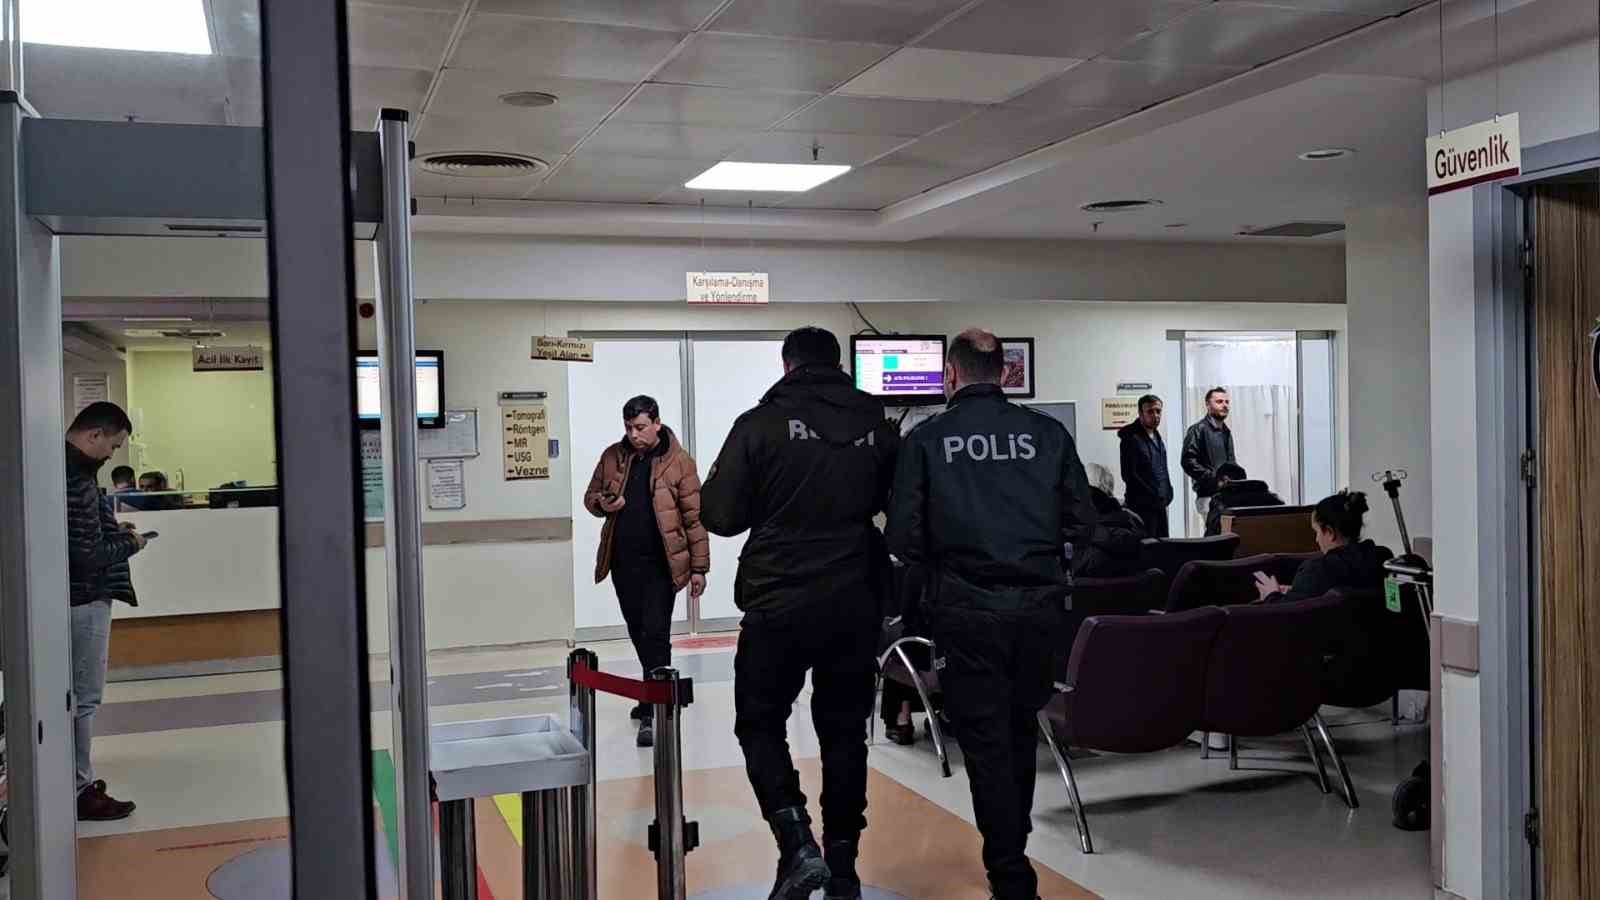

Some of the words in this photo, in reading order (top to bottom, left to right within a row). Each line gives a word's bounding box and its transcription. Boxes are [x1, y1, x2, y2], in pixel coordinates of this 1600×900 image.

[1434, 133, 1510, 179] Güvenlik
[512, 424, 546, 437] Röntgen
[514, 438, 528, 448] MR
[514, 451, 532, 462] USG
[515, 466, 549, 476] Vezne
